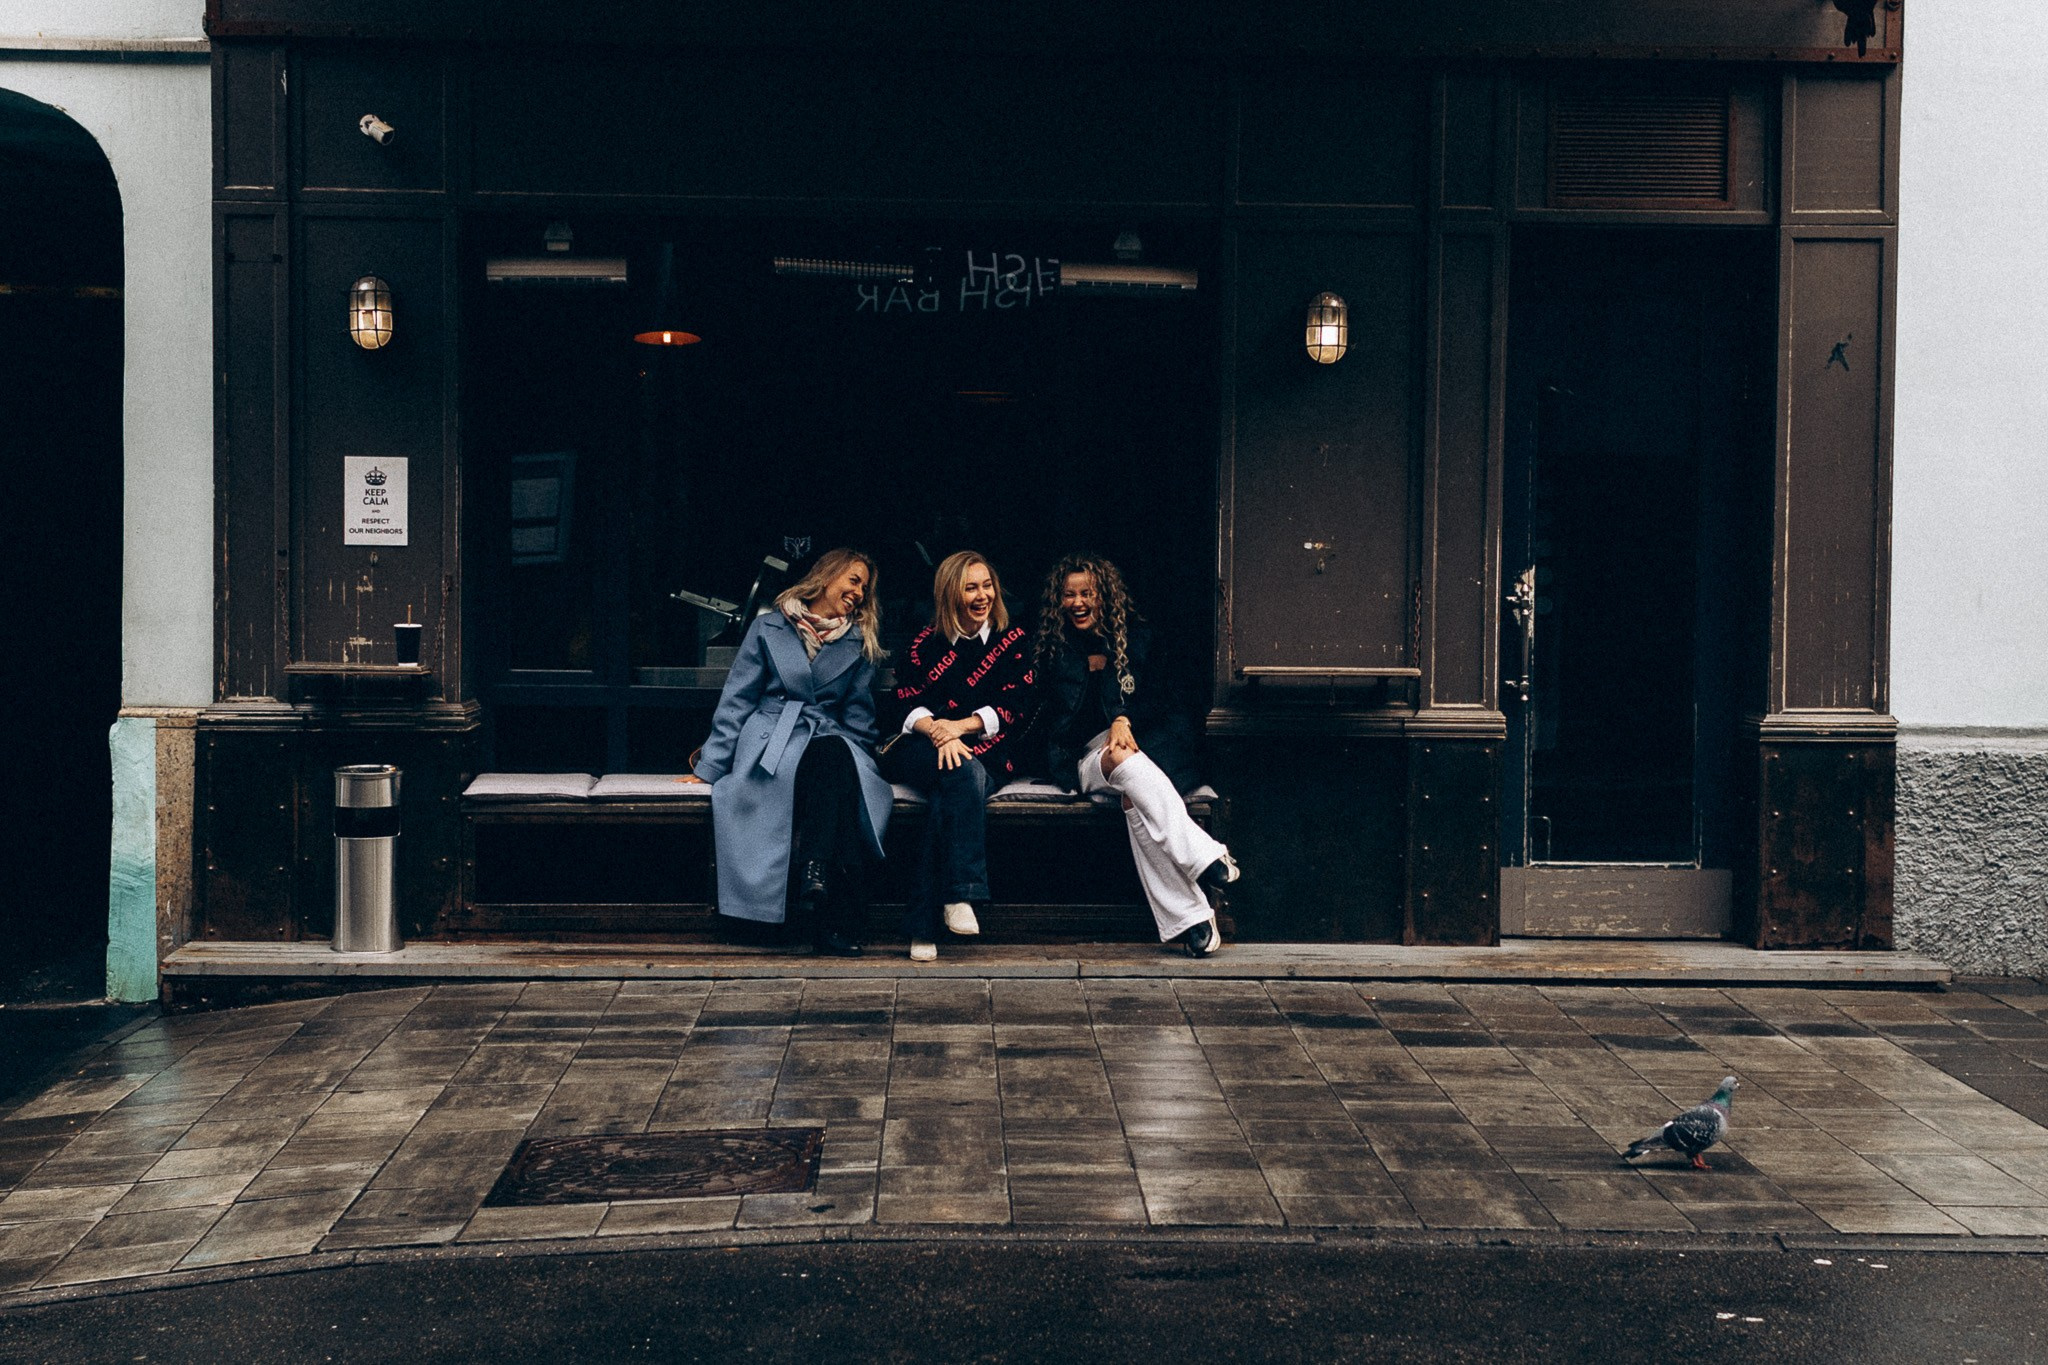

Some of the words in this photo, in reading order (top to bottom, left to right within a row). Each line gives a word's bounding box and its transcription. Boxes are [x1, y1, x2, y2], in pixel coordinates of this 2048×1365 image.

[363, 497, 389, 505] CALM
[897, 650, 959, 699] BALCIAGA
[966, 627, 1026, 687] BALENCIAGA
